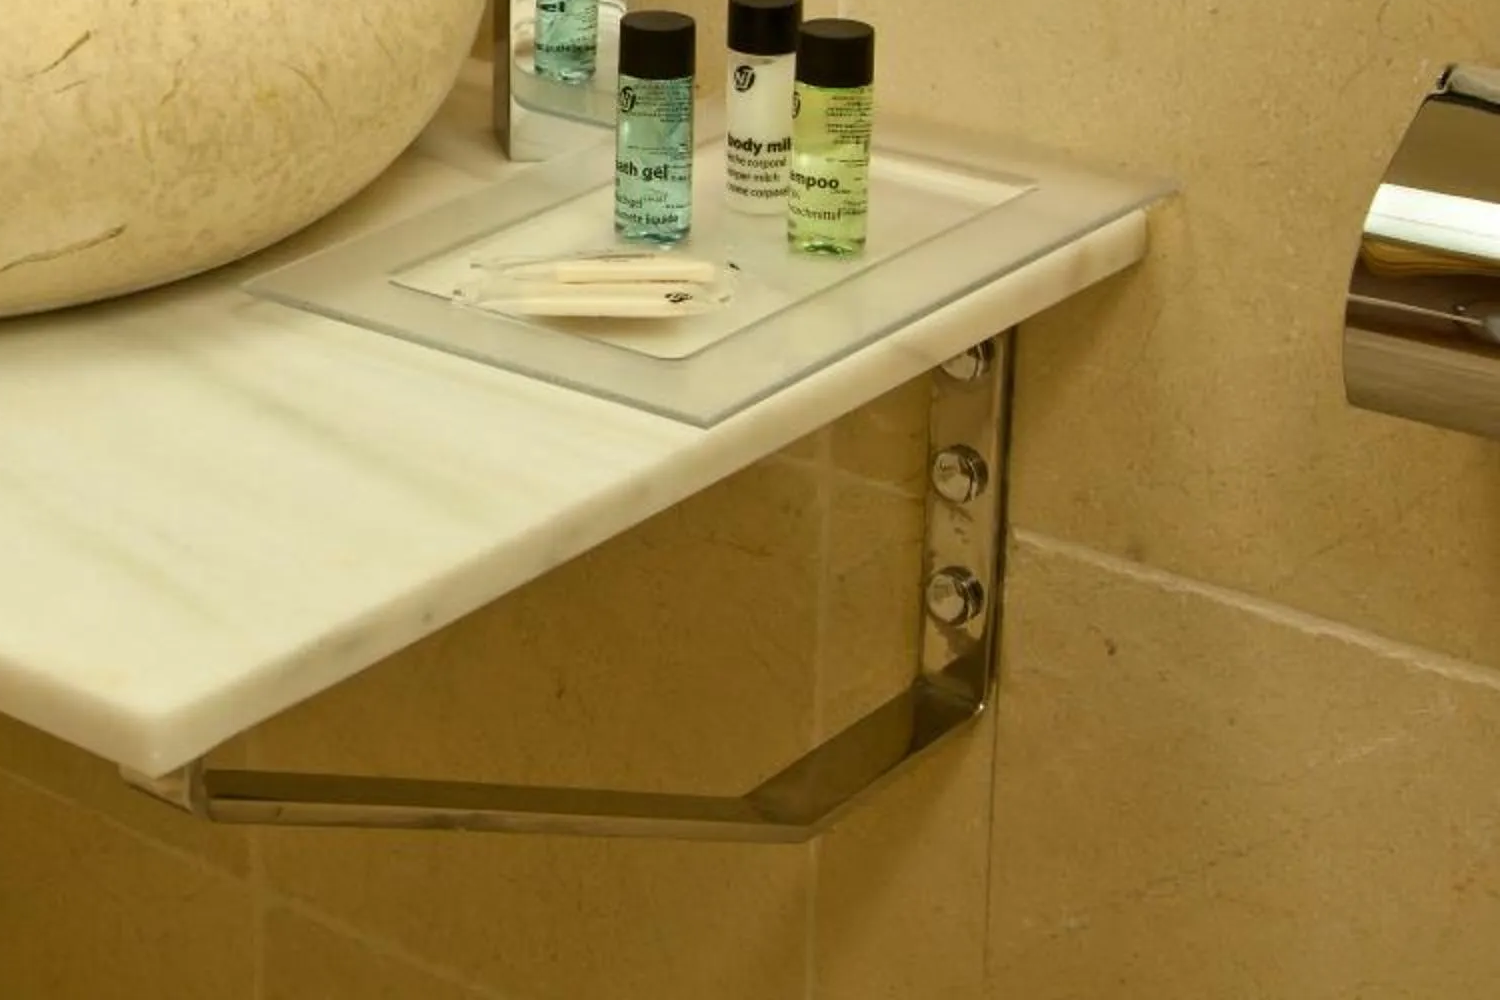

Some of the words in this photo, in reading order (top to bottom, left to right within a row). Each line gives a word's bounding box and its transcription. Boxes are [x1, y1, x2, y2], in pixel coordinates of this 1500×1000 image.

[727, 131, 763, 157] body
[767, 136, 791, 153] mil
[615, 161, 639, 177] ath
[642, 164, 667, 182] gel
